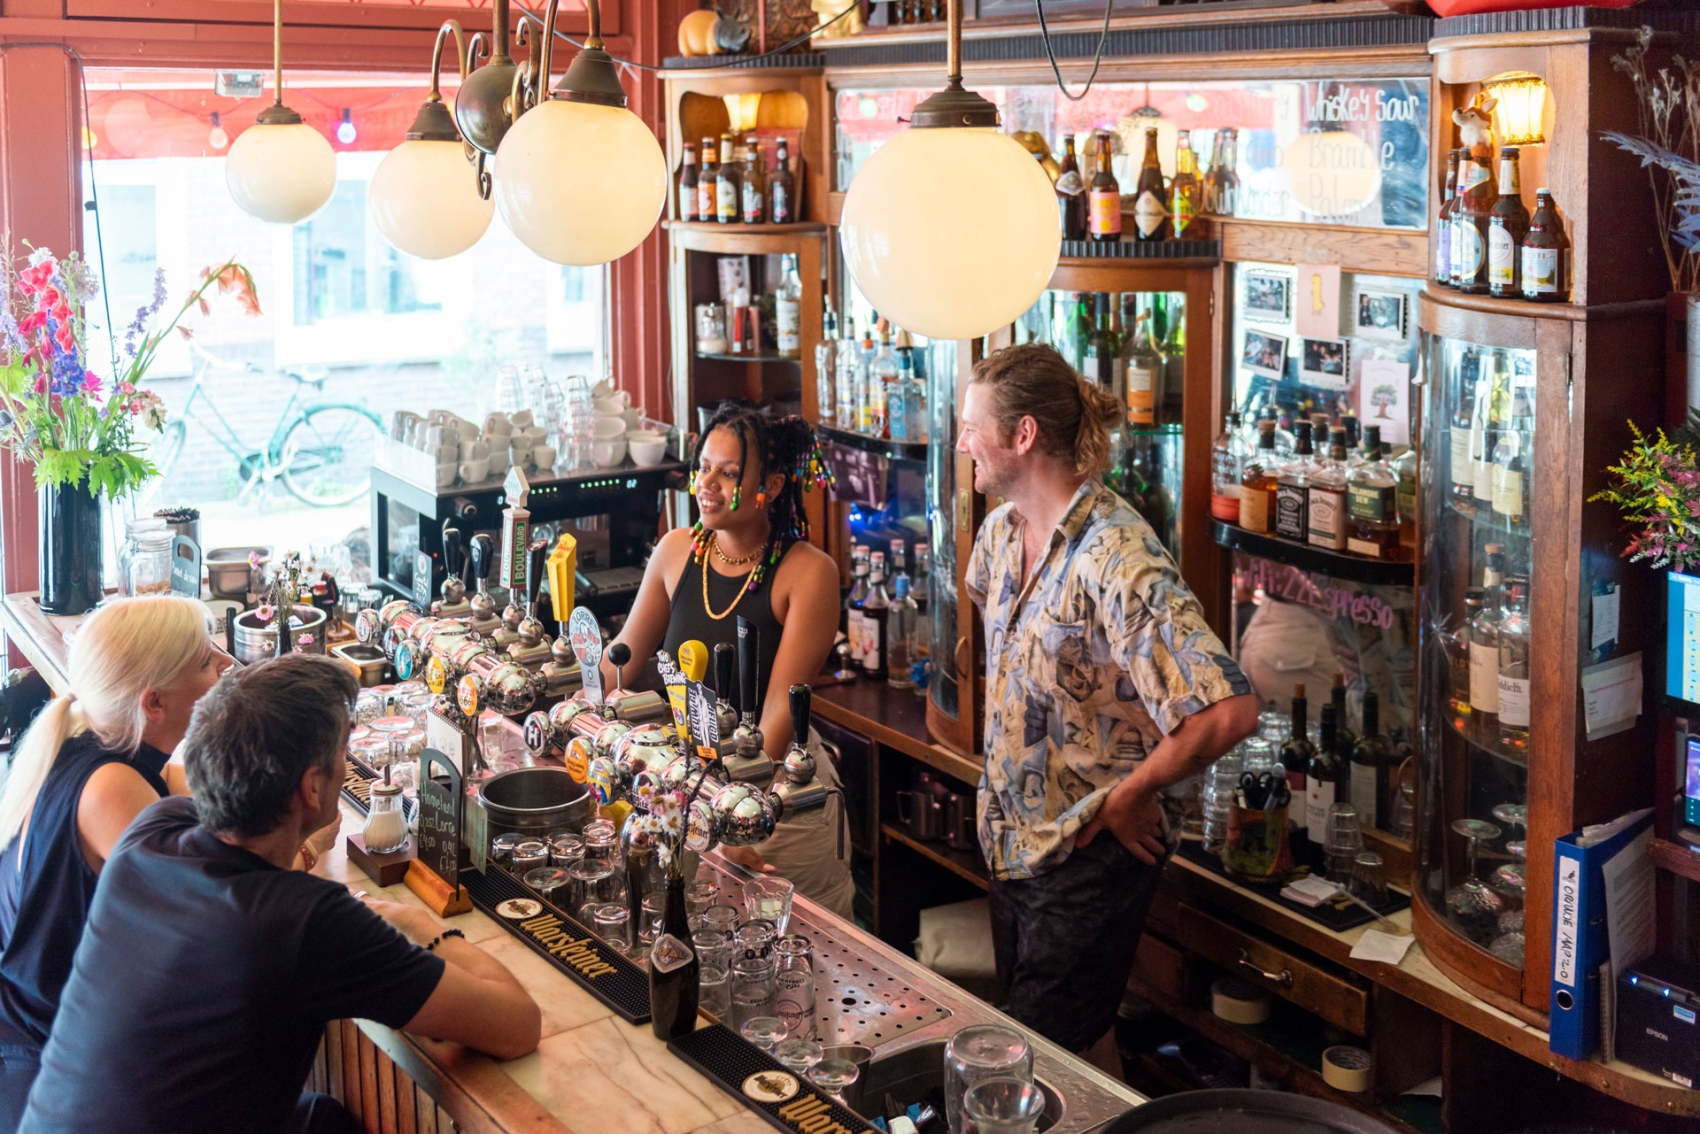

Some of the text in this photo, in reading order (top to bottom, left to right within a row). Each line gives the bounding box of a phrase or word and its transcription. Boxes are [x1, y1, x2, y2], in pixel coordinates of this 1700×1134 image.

[1375, 89, 1419, 122] Sour
[514, 526, 525, 580] BOULEVARD
[520, 913, 618, 979] Warsteiner
